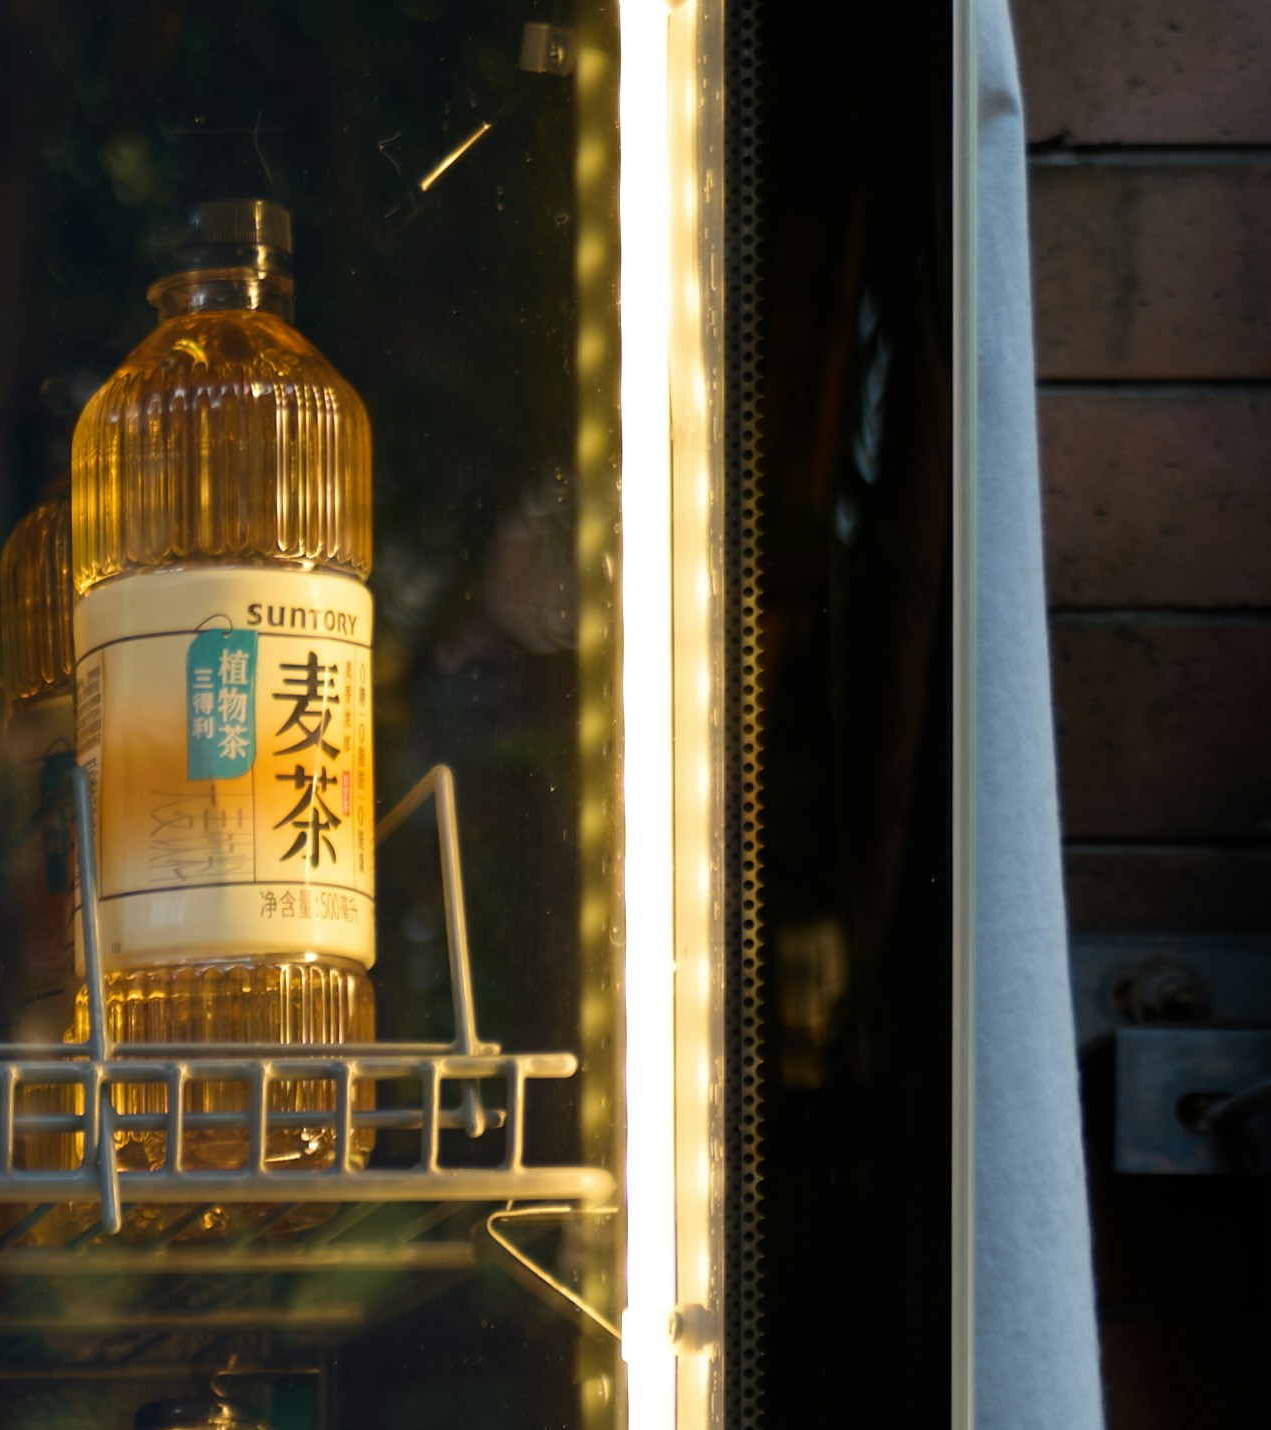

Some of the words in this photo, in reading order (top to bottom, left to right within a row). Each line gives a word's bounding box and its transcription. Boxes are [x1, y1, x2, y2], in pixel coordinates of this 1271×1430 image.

[246, 602, 358, 637] SUNTORY
[192, 668, 215, 740] 三得利
[218, 648, 251, 761] 植物茶
[271, 650, 343, 870] 麦茶
